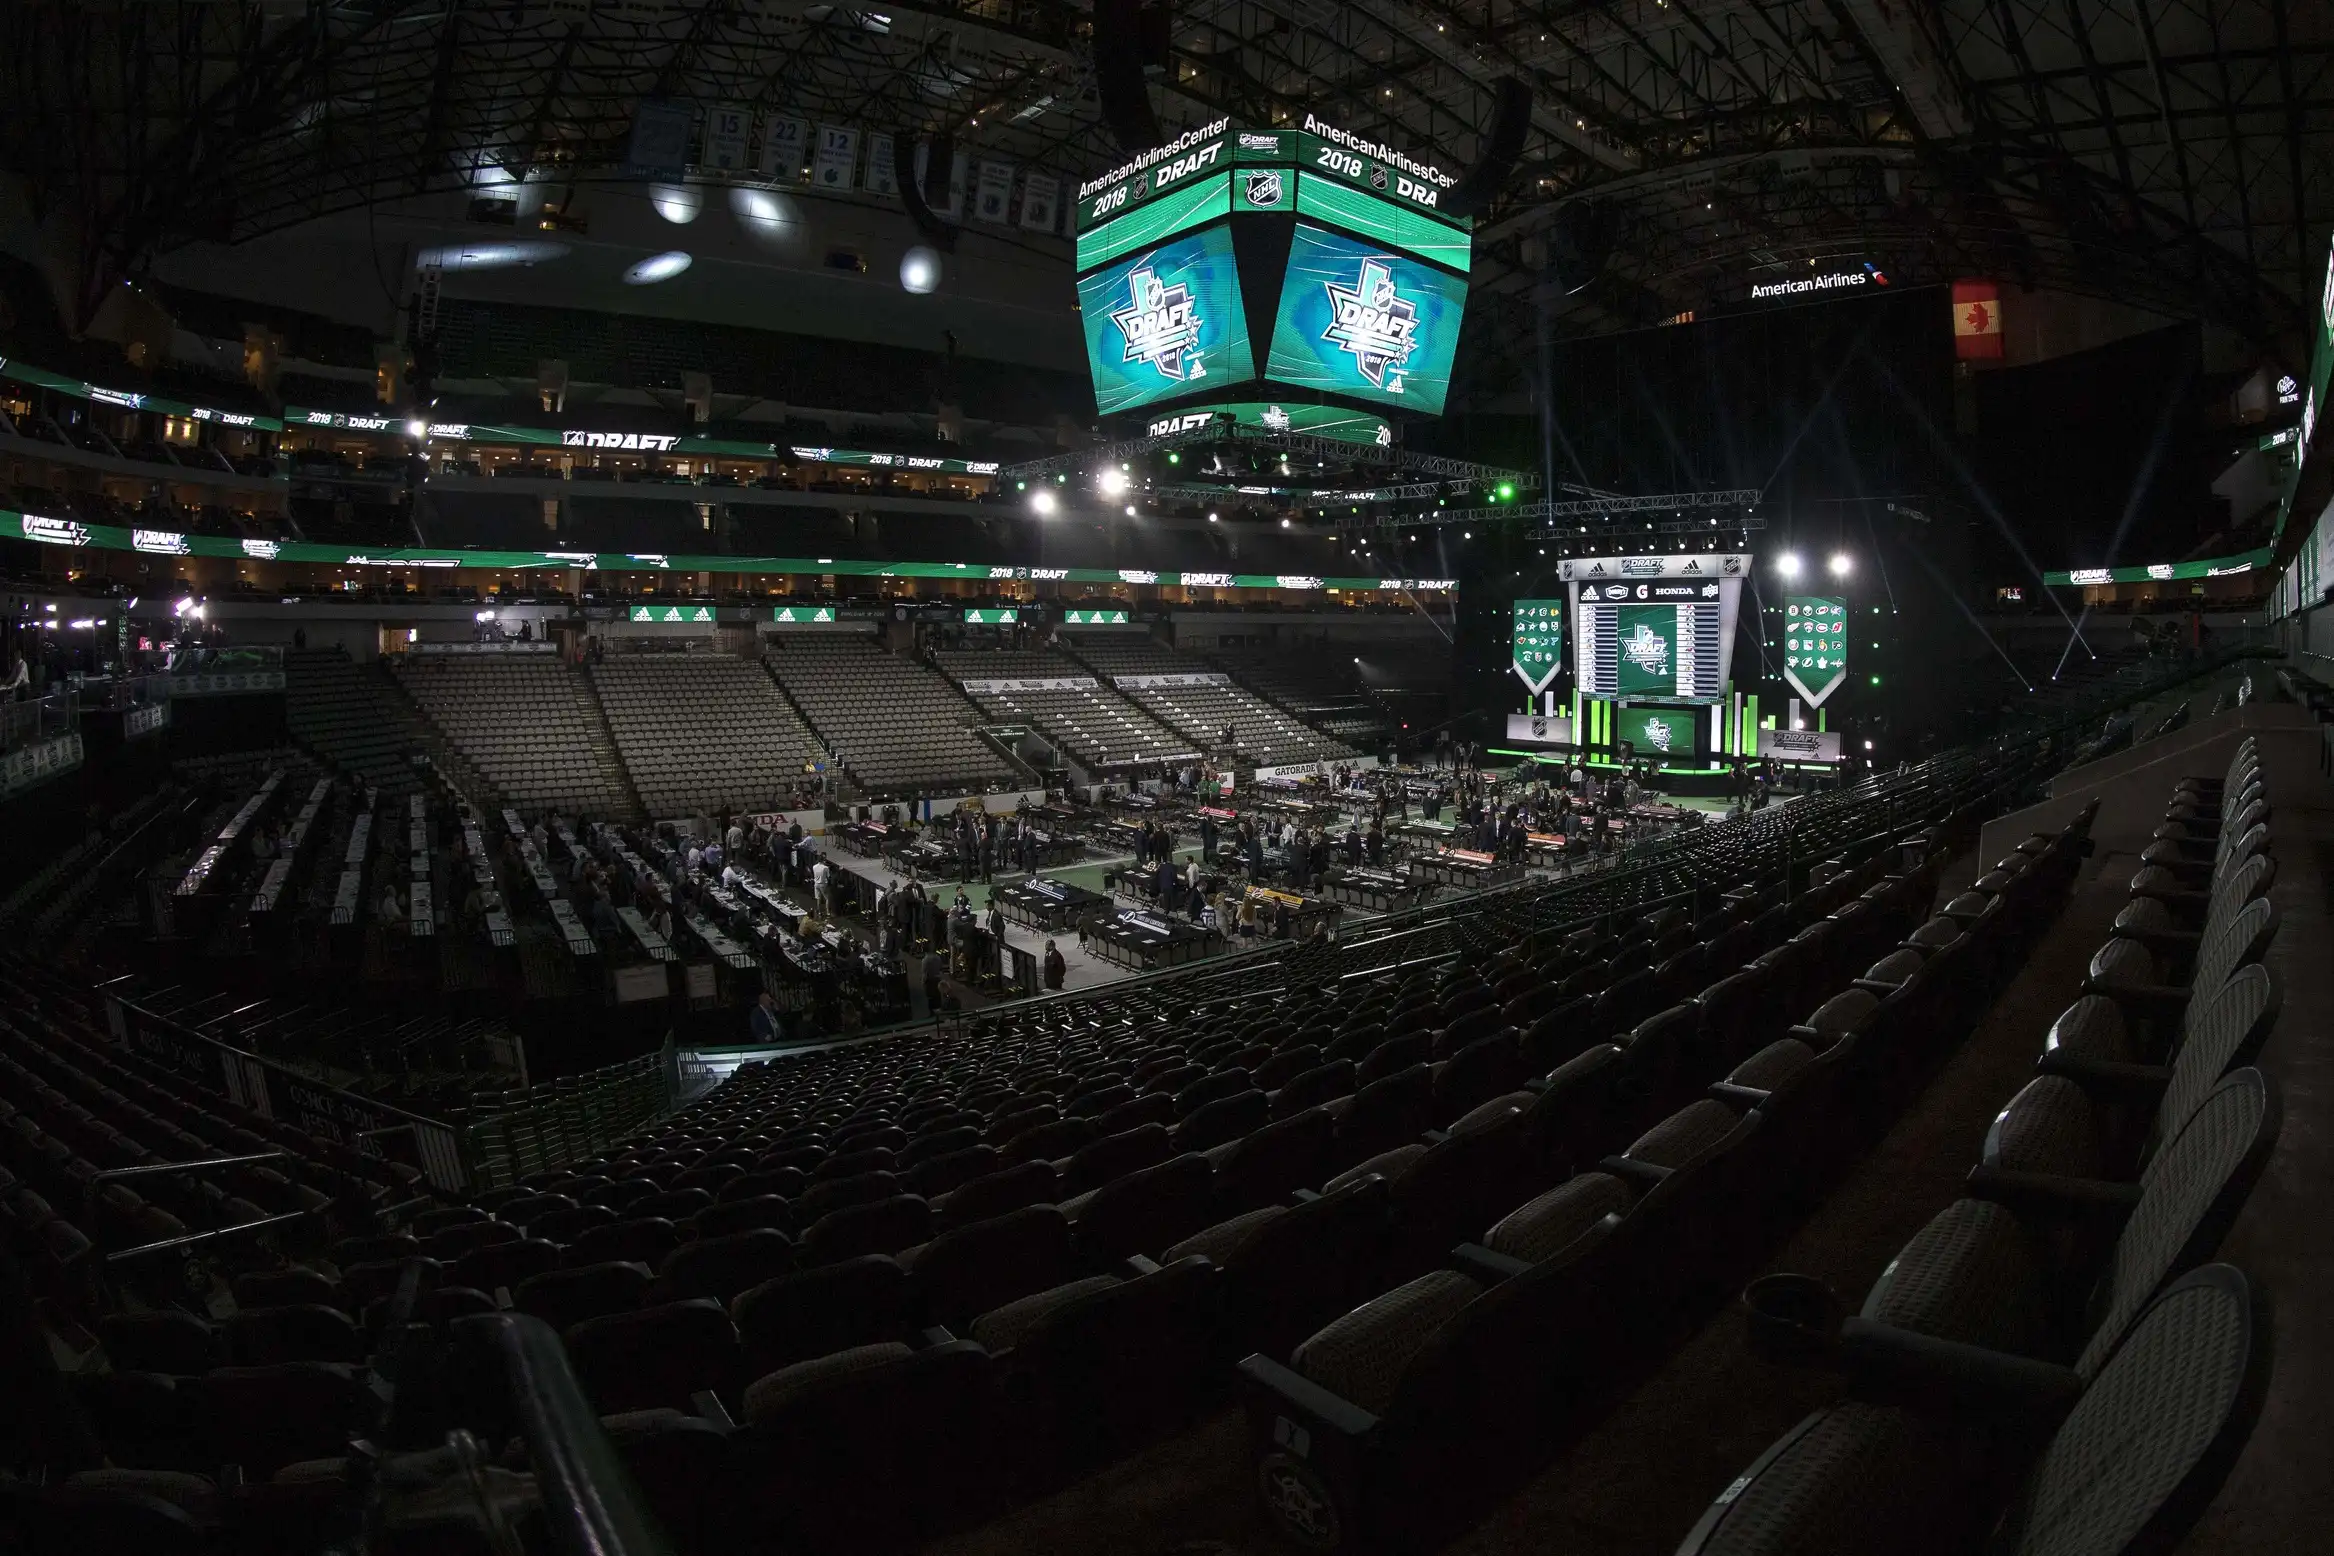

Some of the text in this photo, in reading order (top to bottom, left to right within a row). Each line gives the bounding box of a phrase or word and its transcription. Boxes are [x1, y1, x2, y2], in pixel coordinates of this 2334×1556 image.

[720, 115, 738, 133] 15
[776, 121, 796, 140] 22
[829, 132, 848, 149] 12
[1078, 116, 1229, 200] AmericanAirlinesCenter
[1092, 187, 1127, 218] 2018
[1155, 141, 1224, 188] DRAFT
[1317, 147, 1363, 177] 2018
[1397, 175, 1437, 208] DRA
[1253, 180, 1275, 201] NHL
[1751, 273, 1866, 299] American Airlines
[1127, 300, 1193, 341] DRAFT
[1338, 300, 1417, 340] DRAFT
[192, 408, 255, 426] 2018 DRAFT
[307, 412, 389, 430] 2018 DRAFT
[1149, 412, 1213, 438] DRAFT
[434, 424, 468, 435] DRAFT
[587, 433, 676, 451] DRAFT
[870, 454, 944, 469] 2018 DRAFT
[1631, 558, 1664, 567] DRAFT
[989, 568, 1068, 579] 2018 DRAFT
[1190, 574, 1228, 585] DRAFT
[1379, 580, 1455, 590] 2018 DRAFT
[1636, 585, 1648, 600] G
[1783, 733, 1820, 743] DRAFT
[1275, 764, 1316, 776] GATORADE
